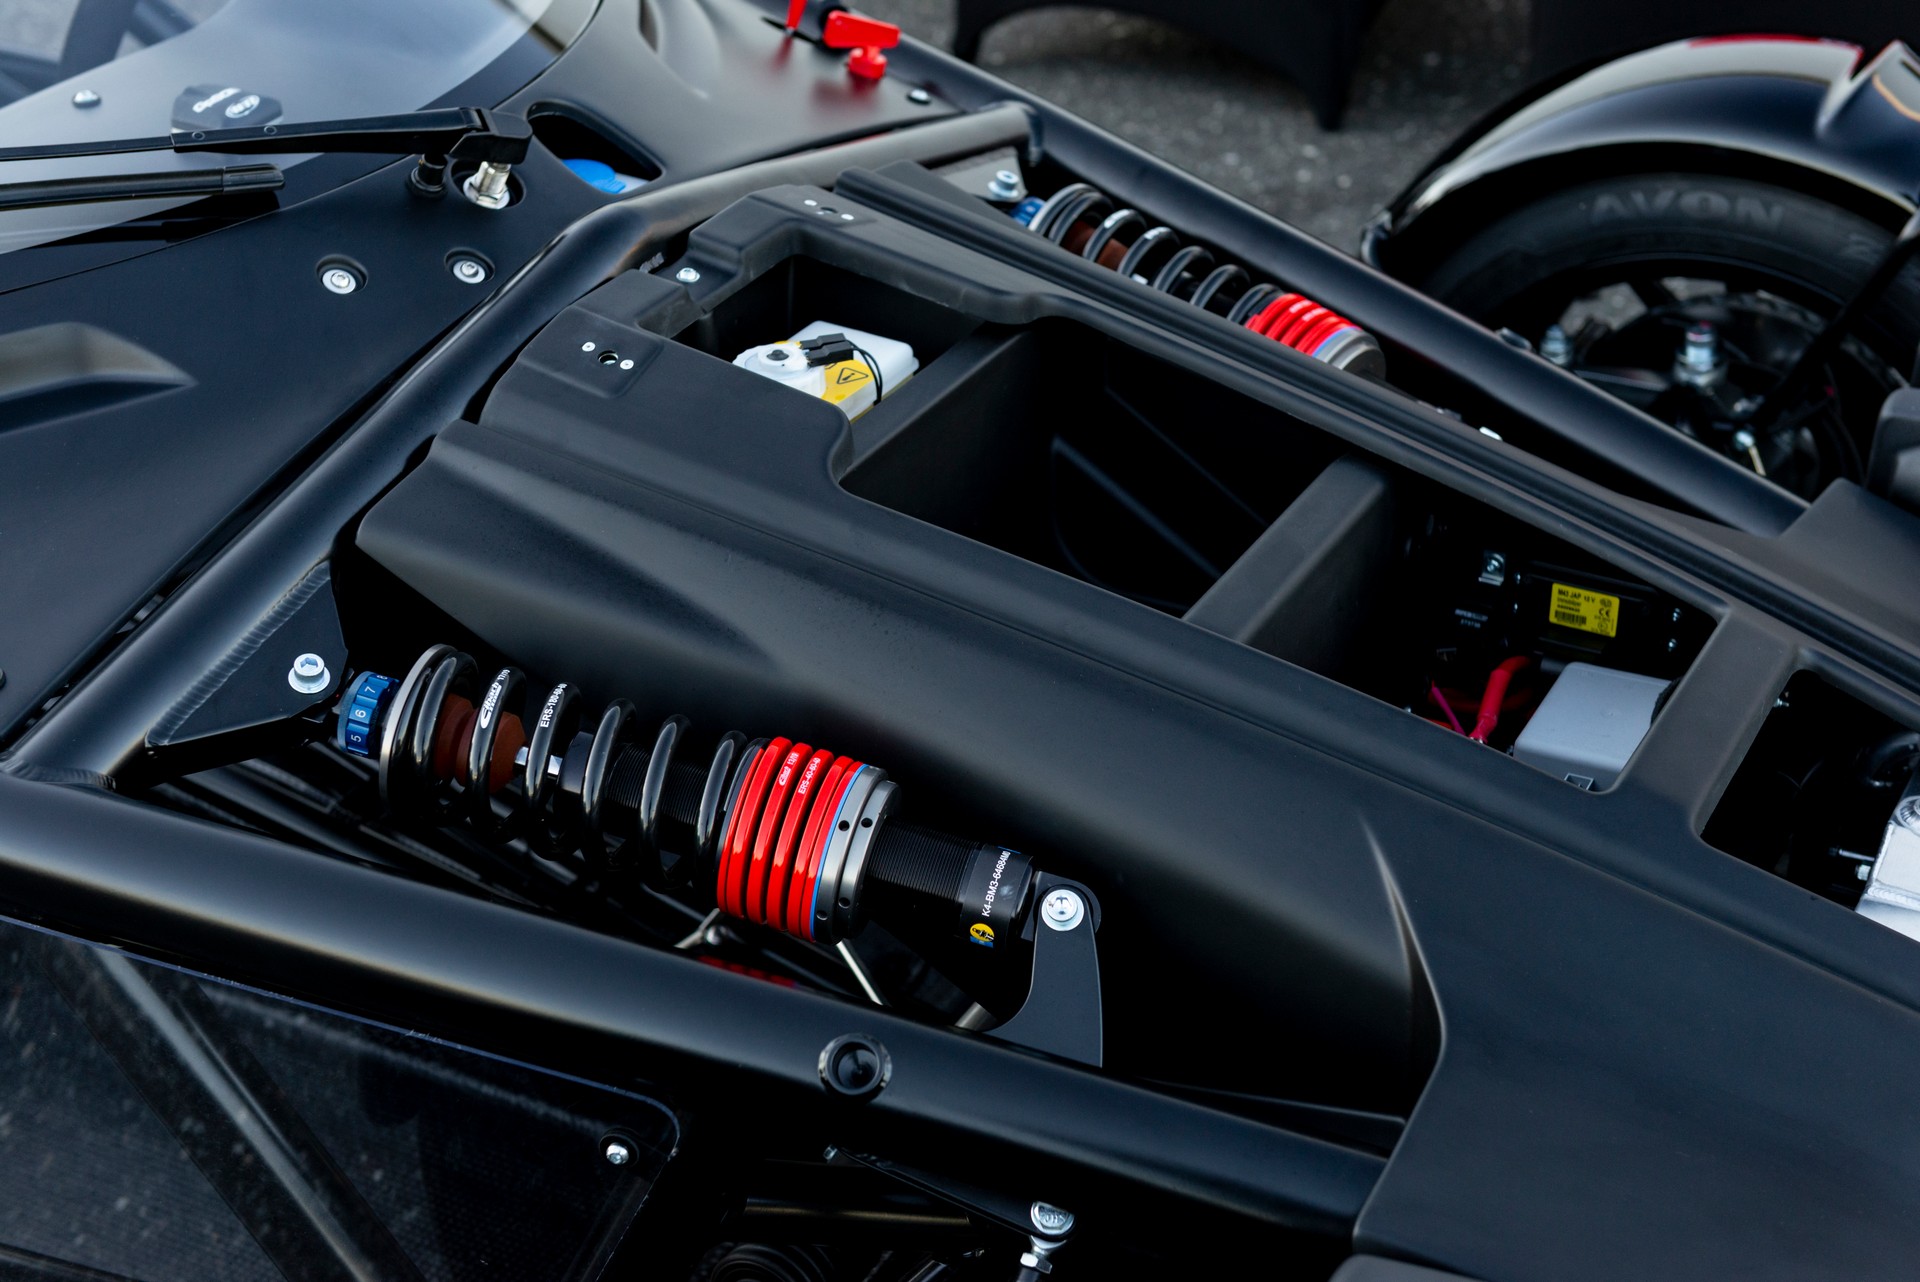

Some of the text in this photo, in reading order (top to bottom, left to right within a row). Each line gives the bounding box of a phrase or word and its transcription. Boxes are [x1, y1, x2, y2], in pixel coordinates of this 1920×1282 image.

[1589, 188, 1785, 231] AVON
[364, 685, 376, 694] 7
[354, 709, 367, 718] 6
[350, 734, 362, 743] 5
